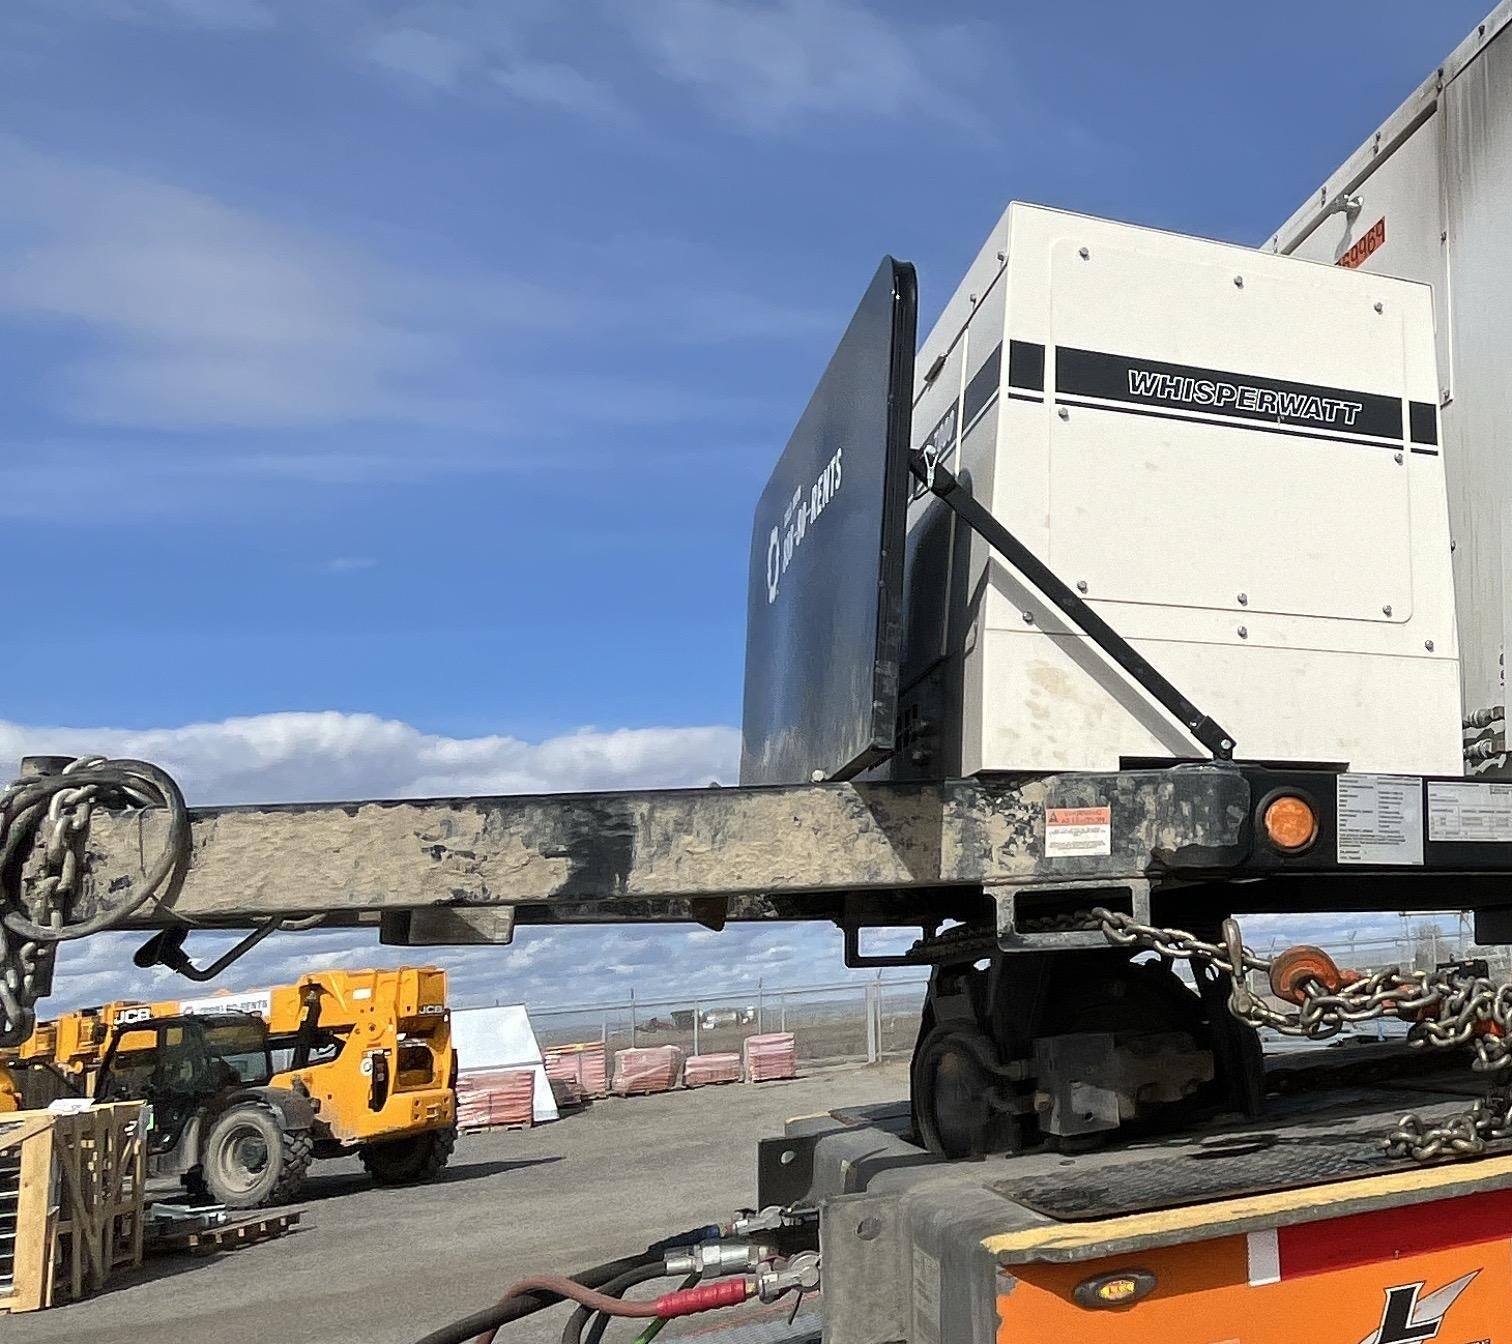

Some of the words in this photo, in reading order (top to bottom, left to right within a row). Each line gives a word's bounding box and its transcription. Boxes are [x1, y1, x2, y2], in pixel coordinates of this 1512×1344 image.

[1335, 218, 1386, 269] 69969
[1127, 368, 1364, 426] WHISPERWATT
[113, 1008, 152, 1026] JCB
[418, 1004, 443, 1015] JCB
